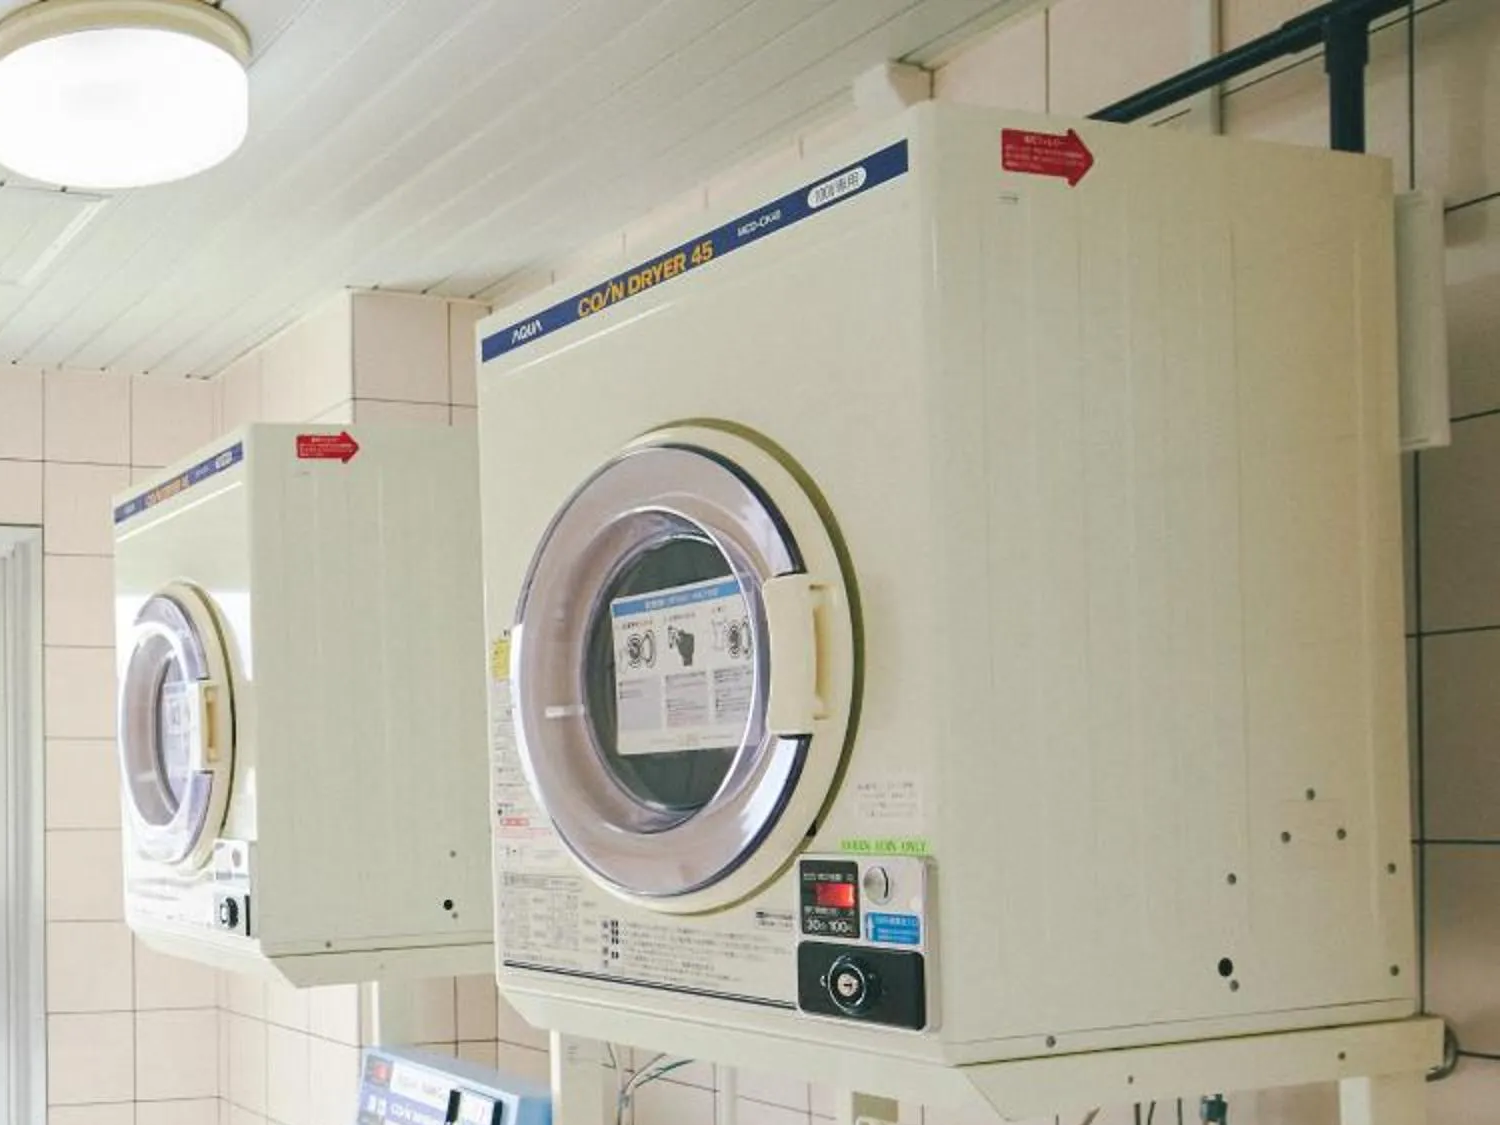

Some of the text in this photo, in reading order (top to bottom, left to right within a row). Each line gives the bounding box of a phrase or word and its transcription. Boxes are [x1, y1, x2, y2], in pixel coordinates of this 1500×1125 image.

[511, 319, 543, 345] AQUA
[627, 252, 686, 294] DRYER
[691, 239, 714, 263] 45
